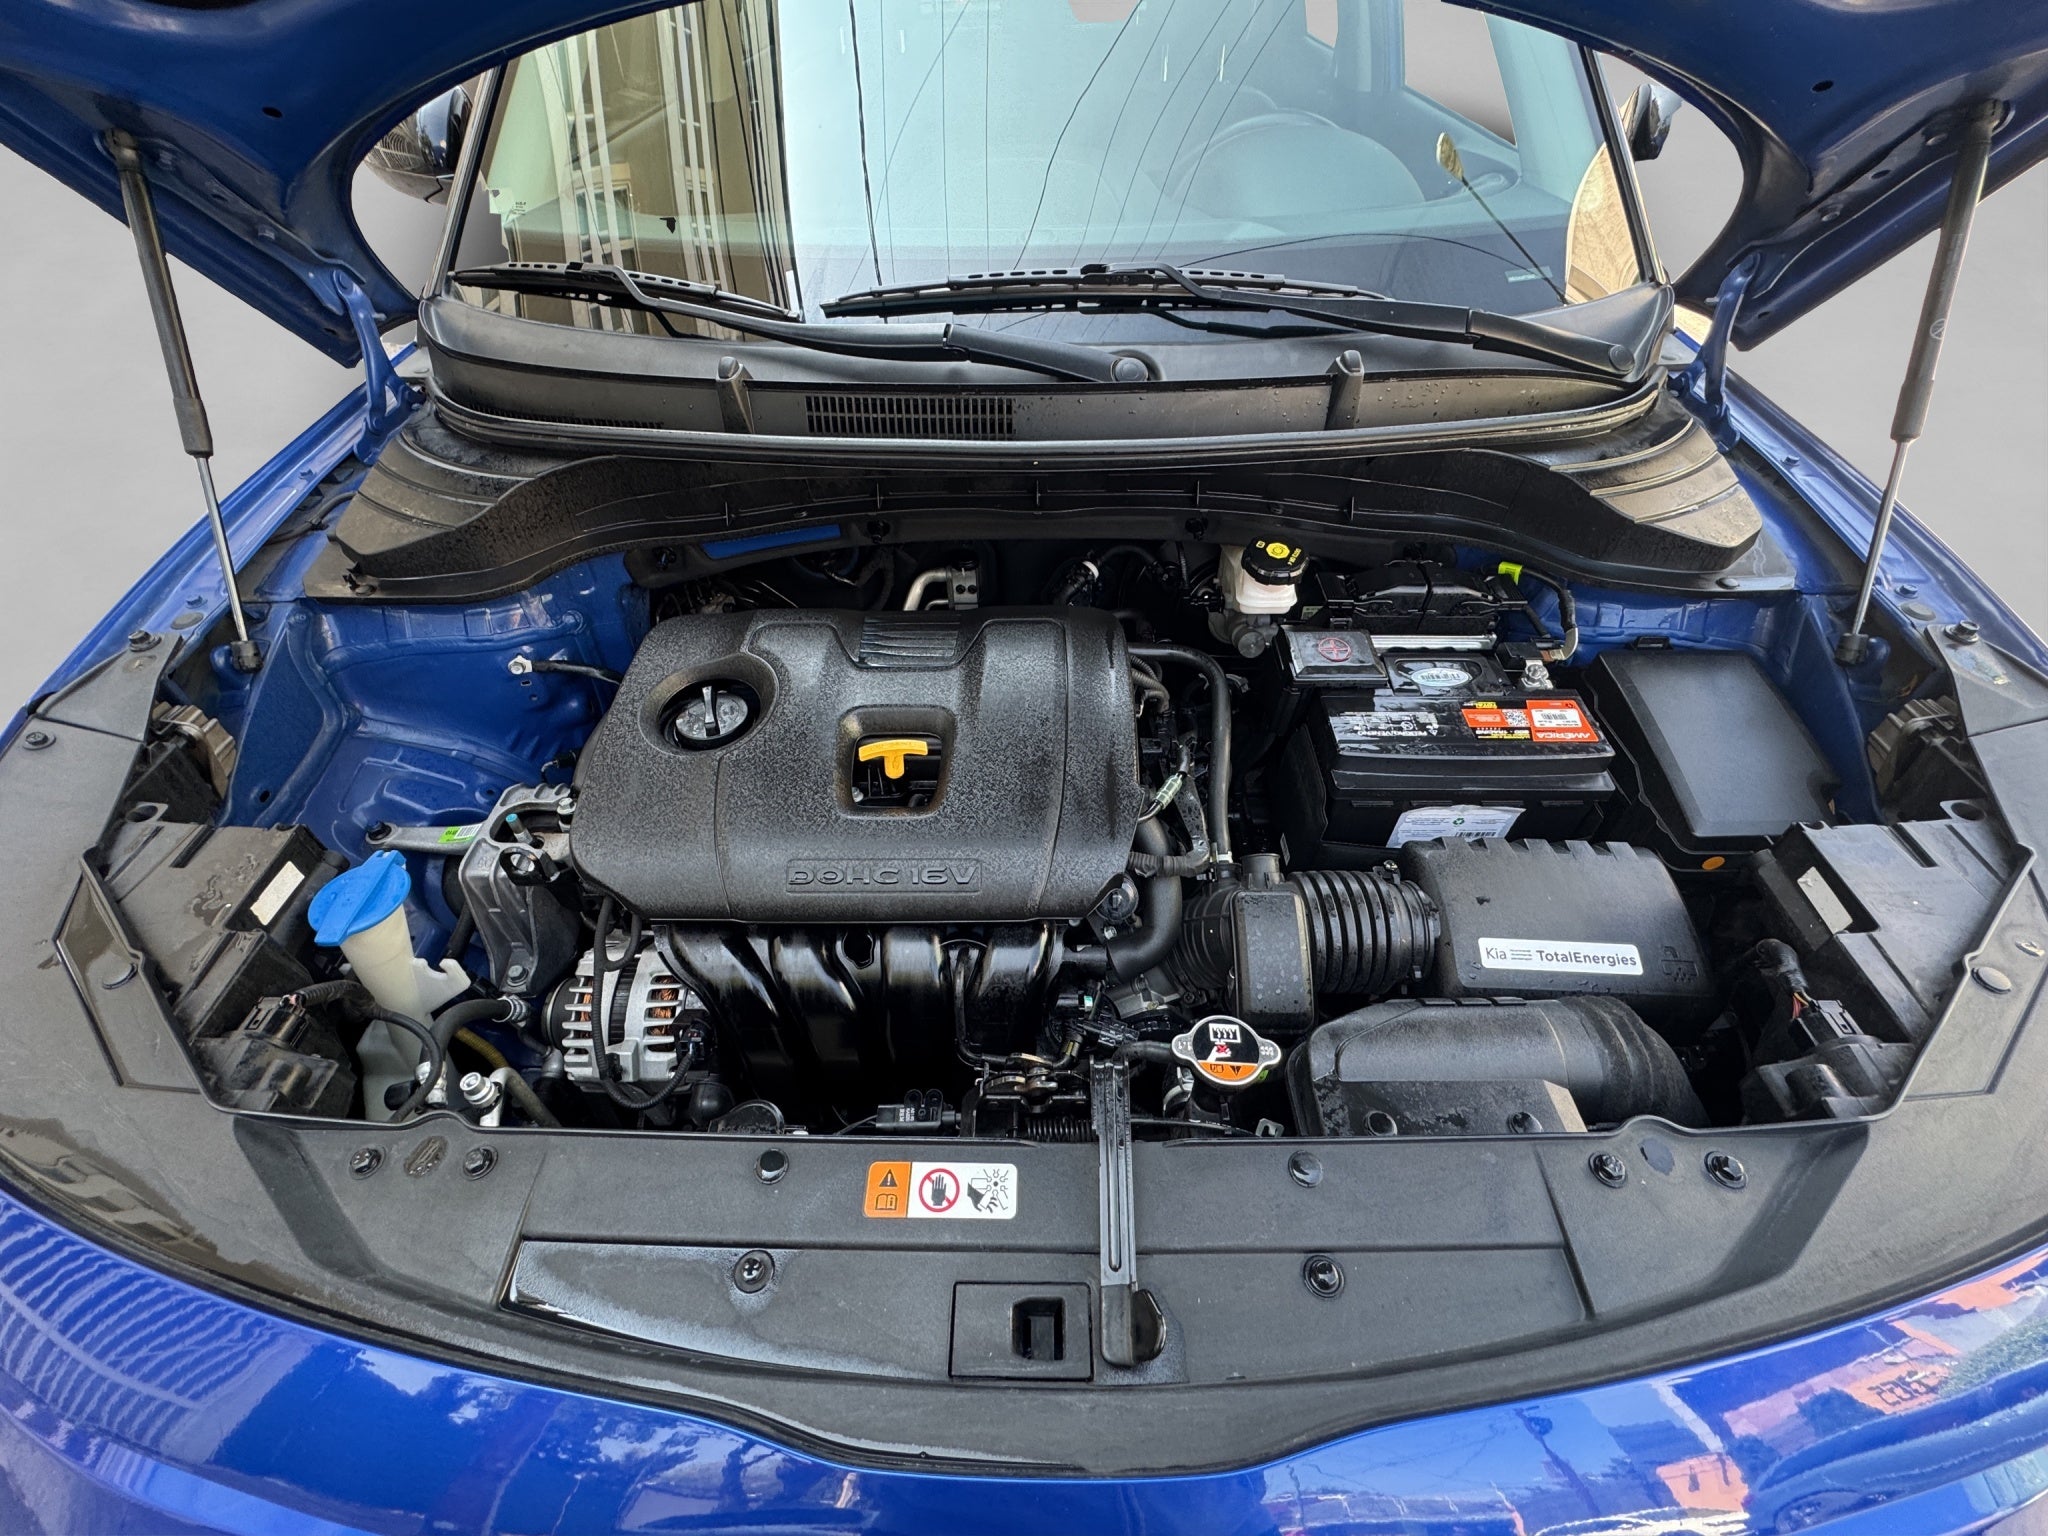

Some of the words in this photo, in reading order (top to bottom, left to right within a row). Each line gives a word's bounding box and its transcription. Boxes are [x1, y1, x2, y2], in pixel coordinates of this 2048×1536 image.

[788, 866, 900, 885] DOHC
[910, 866, 977, 885] 16V
[1485, 947, 1507, 960] Kia
[1536, 950, 1637, 967] TotalEnergies
